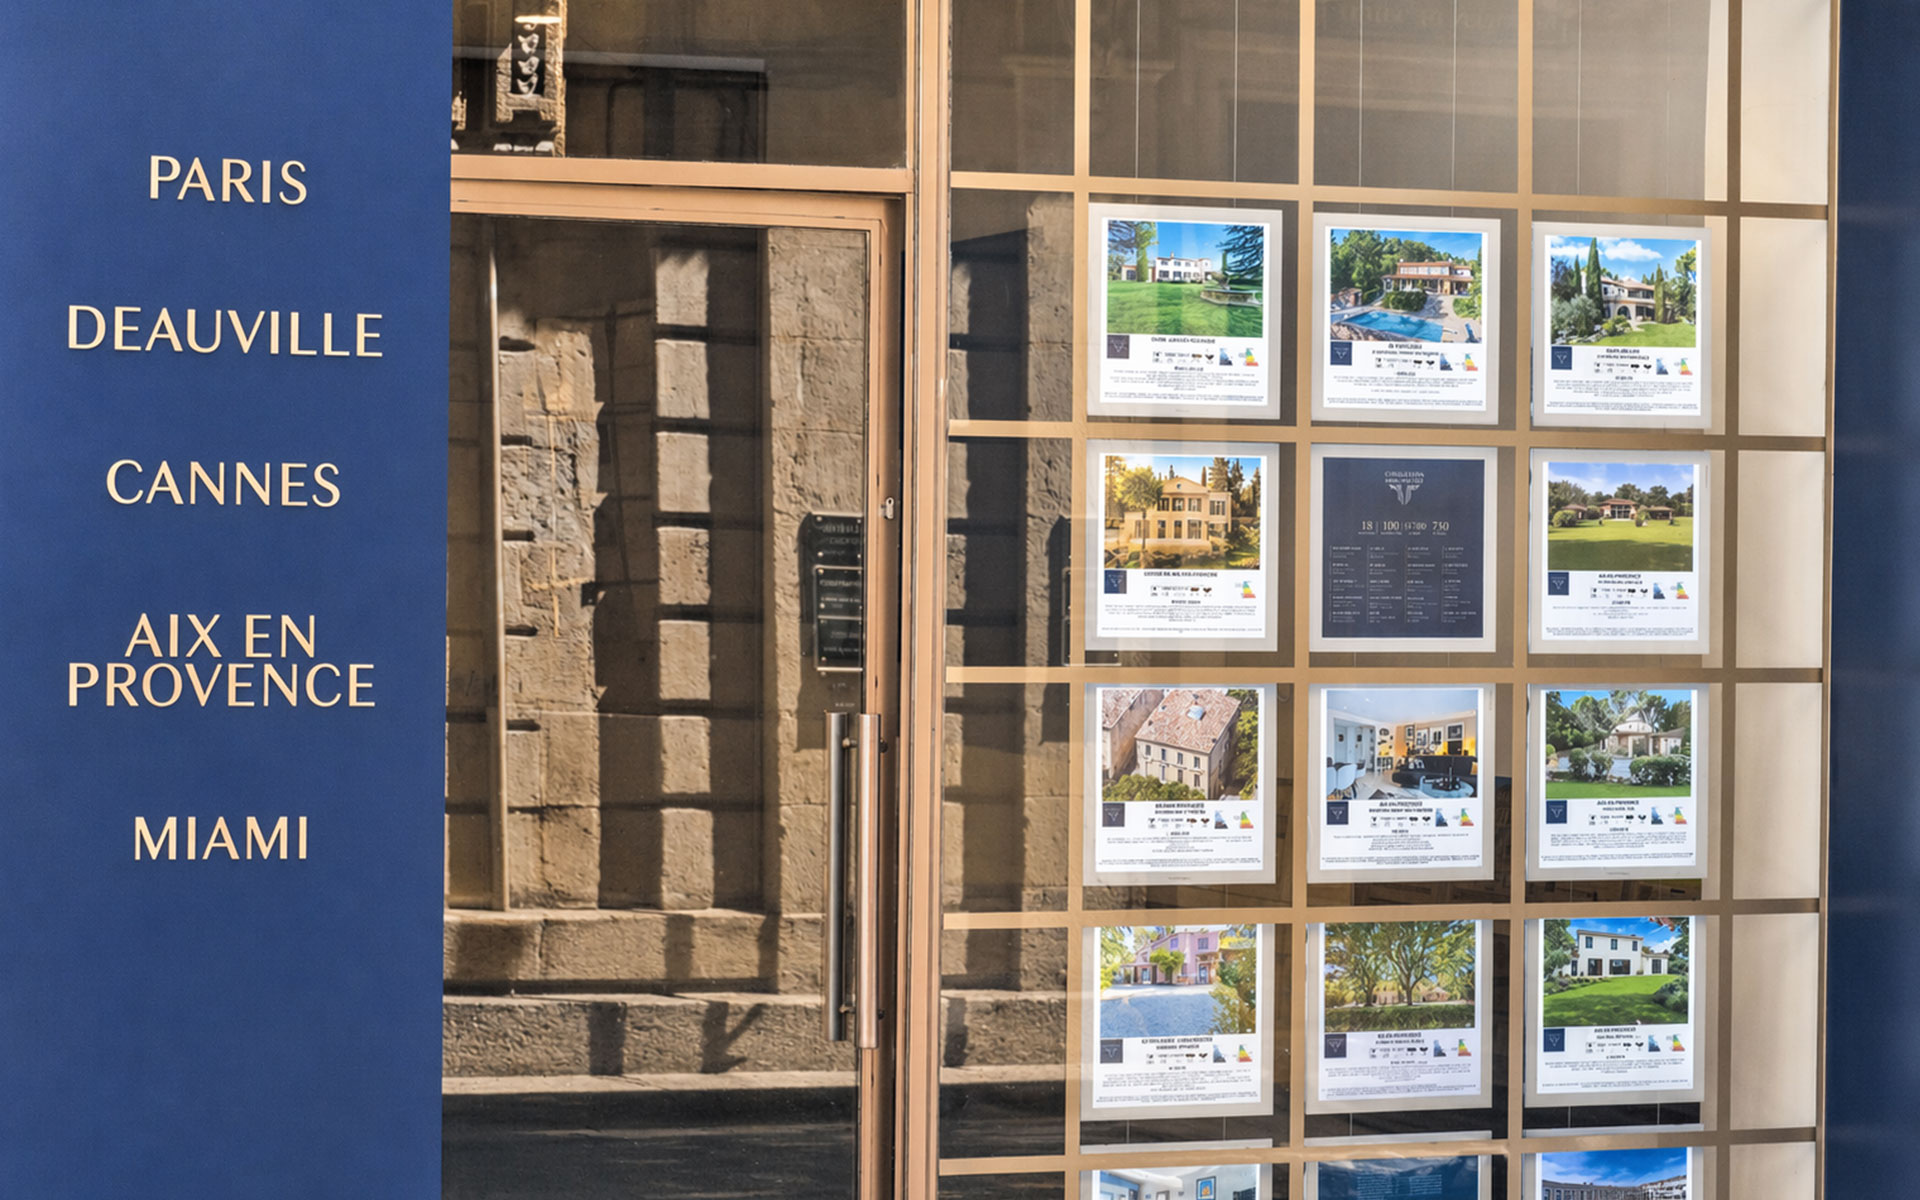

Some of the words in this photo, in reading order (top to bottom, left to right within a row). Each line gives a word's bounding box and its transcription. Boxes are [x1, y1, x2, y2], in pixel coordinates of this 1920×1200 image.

[149, 155, 307, 205] PARIS
[68, 304, 383, 357] DEAUVILLE
[106, 459, 341, 508] CANNES
[124, 612, 222, 658] AIX
[245, 614, 315, 658] EN
[68, 662, 376, 707] PROVENCE
[134, 816, 308, 861] MIAMI
